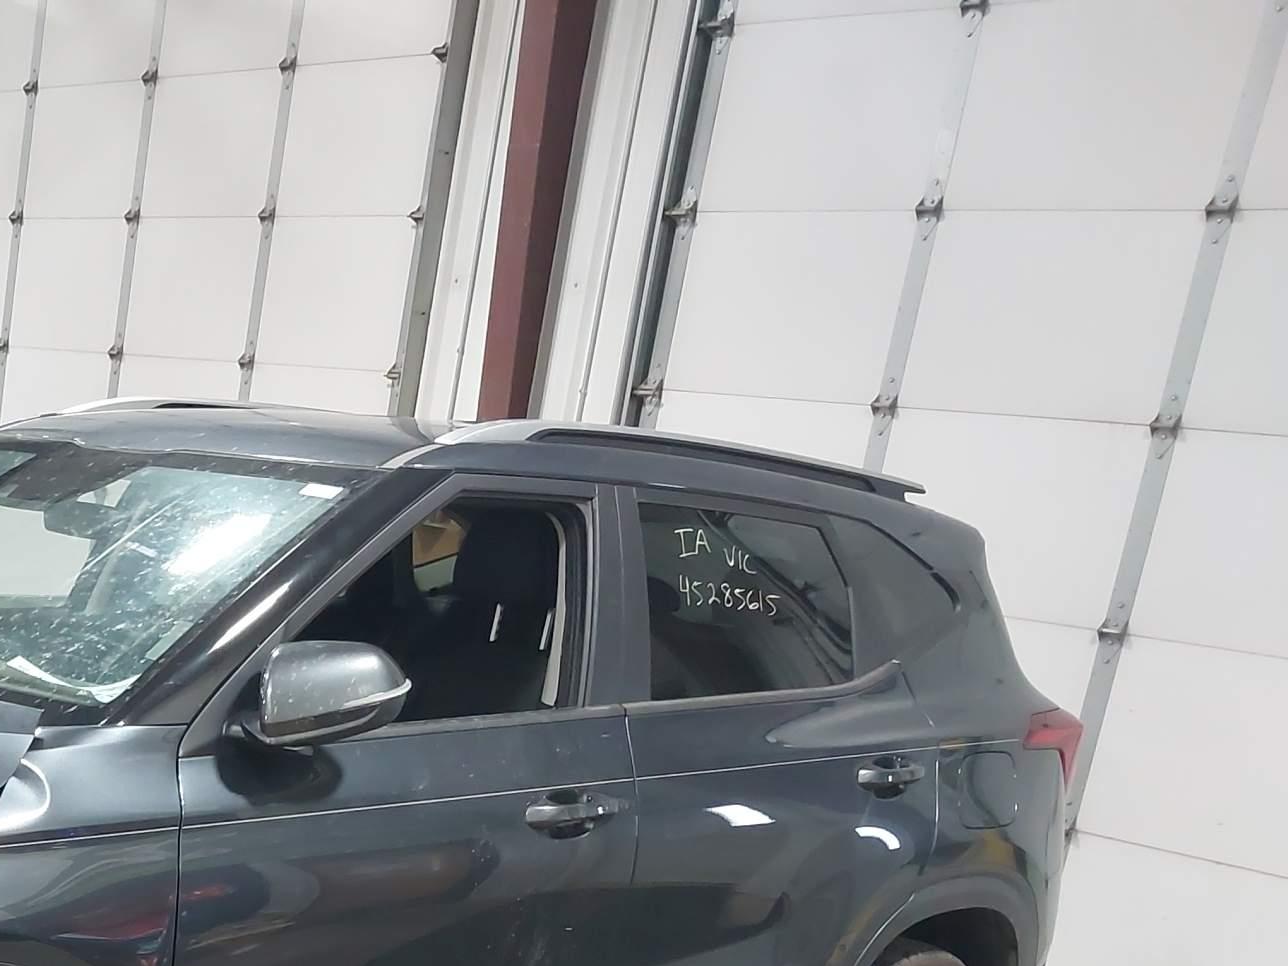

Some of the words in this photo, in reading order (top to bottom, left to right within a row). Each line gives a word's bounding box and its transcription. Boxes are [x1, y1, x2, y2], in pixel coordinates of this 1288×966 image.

[673, 528, 712, 558] IA
[723, 545, 758, 575] VIC
[679, 574, 782, 616] 45285615
